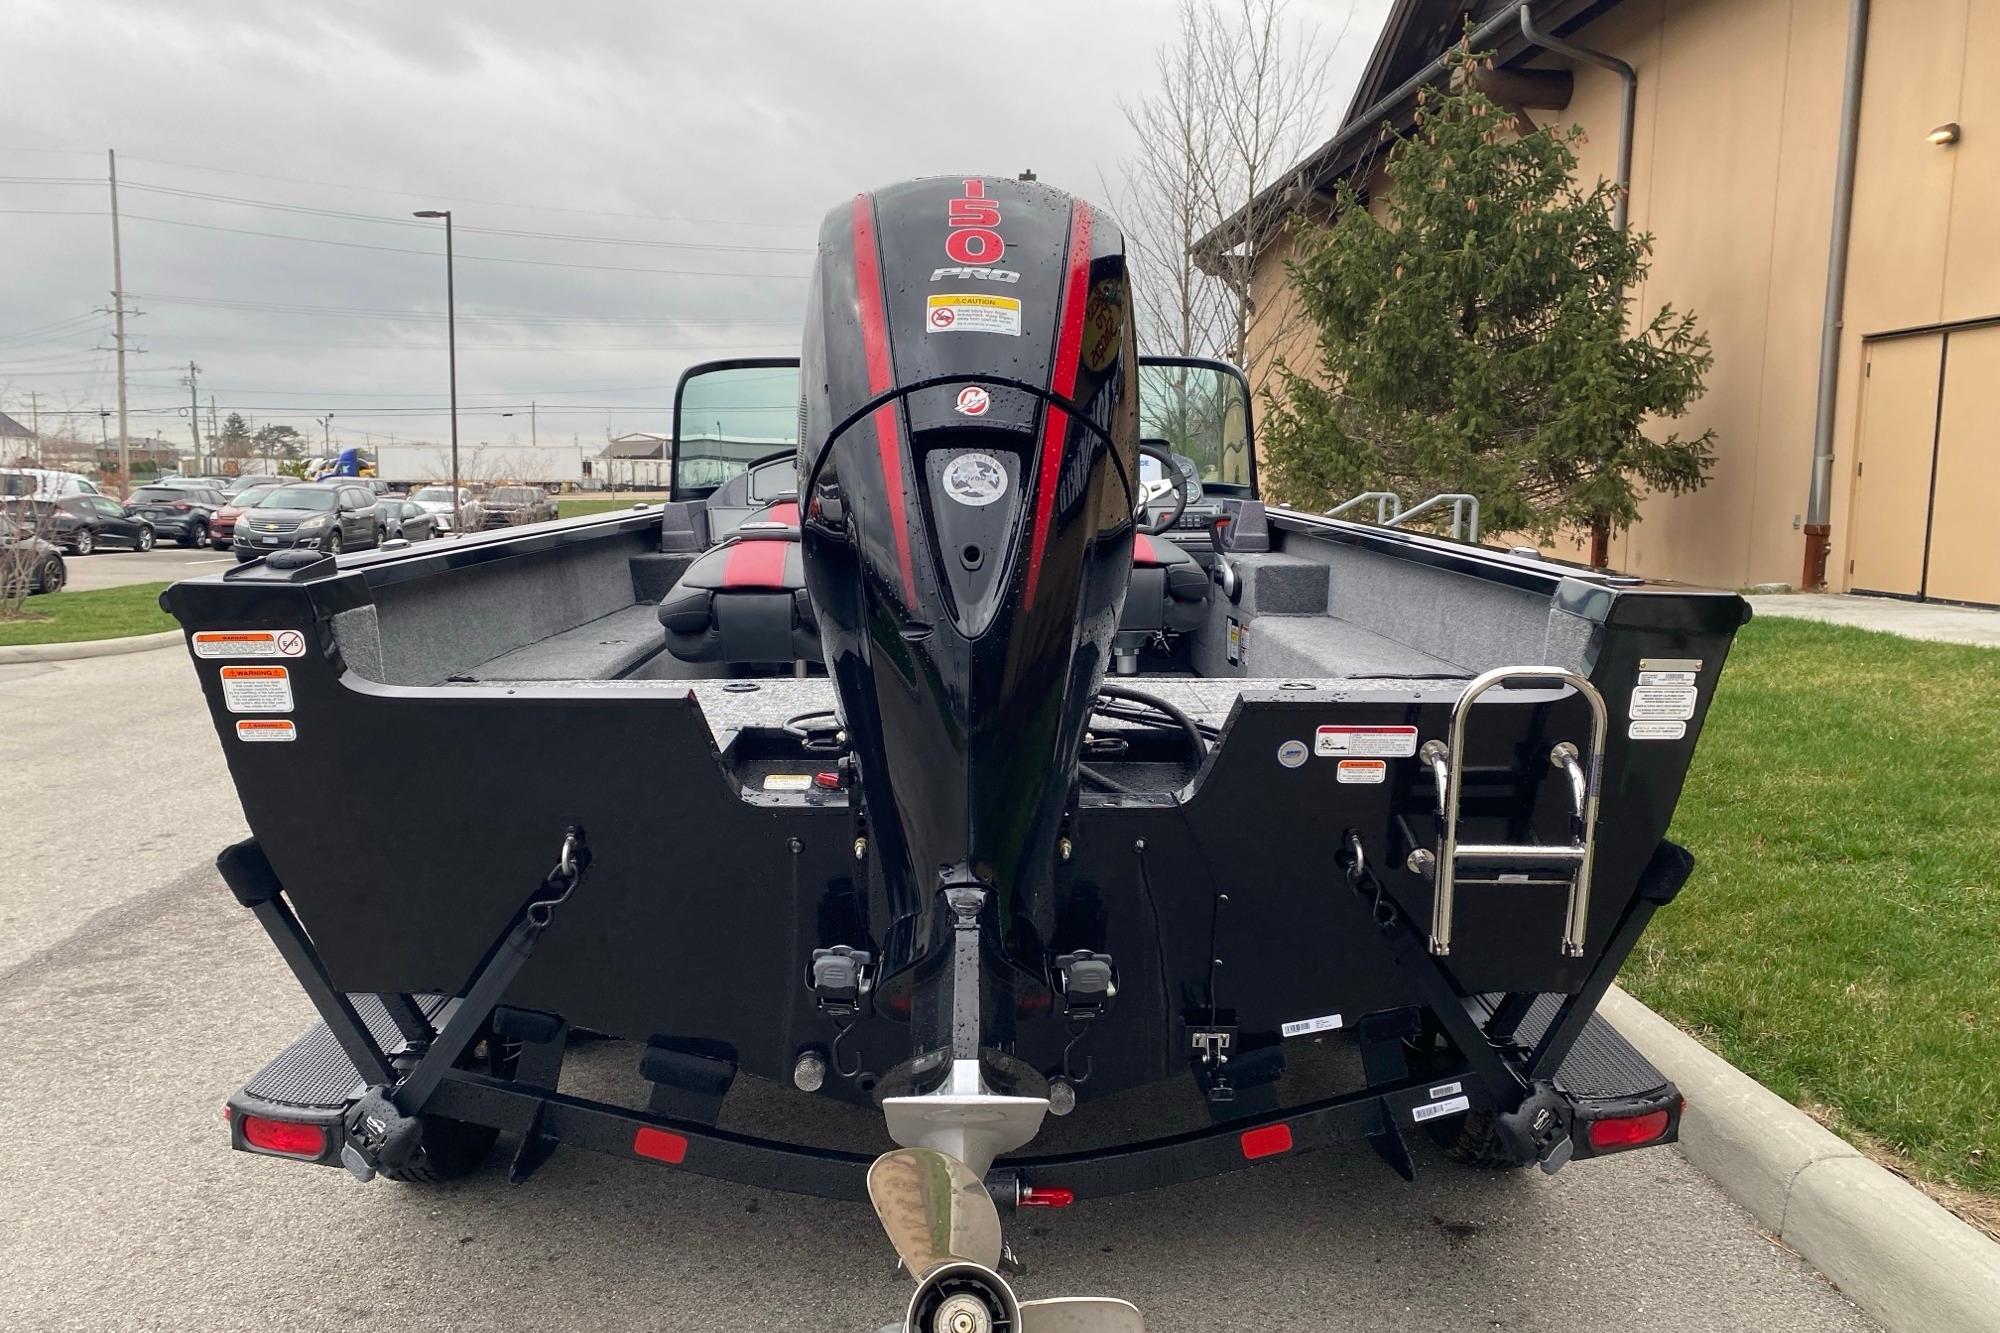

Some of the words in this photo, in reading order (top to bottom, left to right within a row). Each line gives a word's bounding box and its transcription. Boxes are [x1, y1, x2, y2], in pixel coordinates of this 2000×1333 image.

[945, 179, 1005, 265] 150
[928, 267, 1022, 284] PRO
[961, 298, 996, 306] CAUTION
